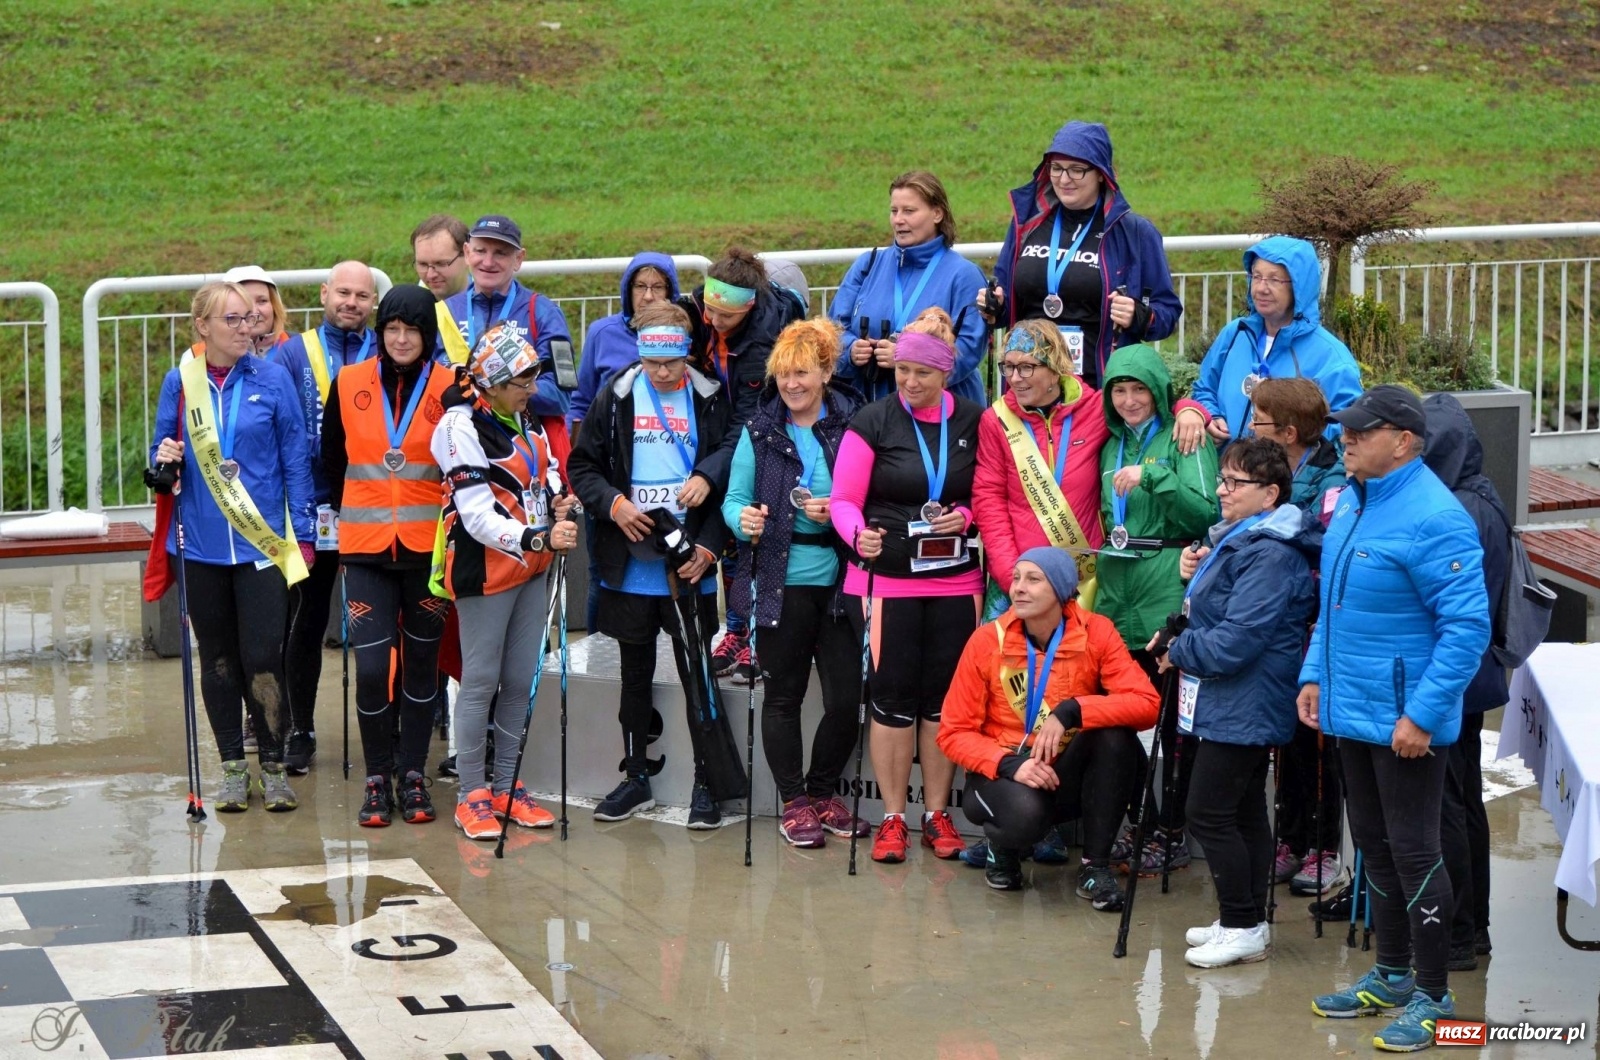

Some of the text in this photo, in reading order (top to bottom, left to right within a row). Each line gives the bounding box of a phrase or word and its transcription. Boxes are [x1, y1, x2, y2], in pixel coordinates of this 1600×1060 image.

[203, 462, 211, 475] Po
[208, 474, 230, 508] zdrowie
[228, 506, 248, 530] marsz
[638, 487, 671, 504] 022
[1020, 469, 1064, 543] Po zdrowie marsz
[1025, 454, 1078, 546] Marsz Nordic Walking
[238, 501, 262, 532] Walking
[351, 933, 458, 961] G
[397, 994, 516, 1016] F
